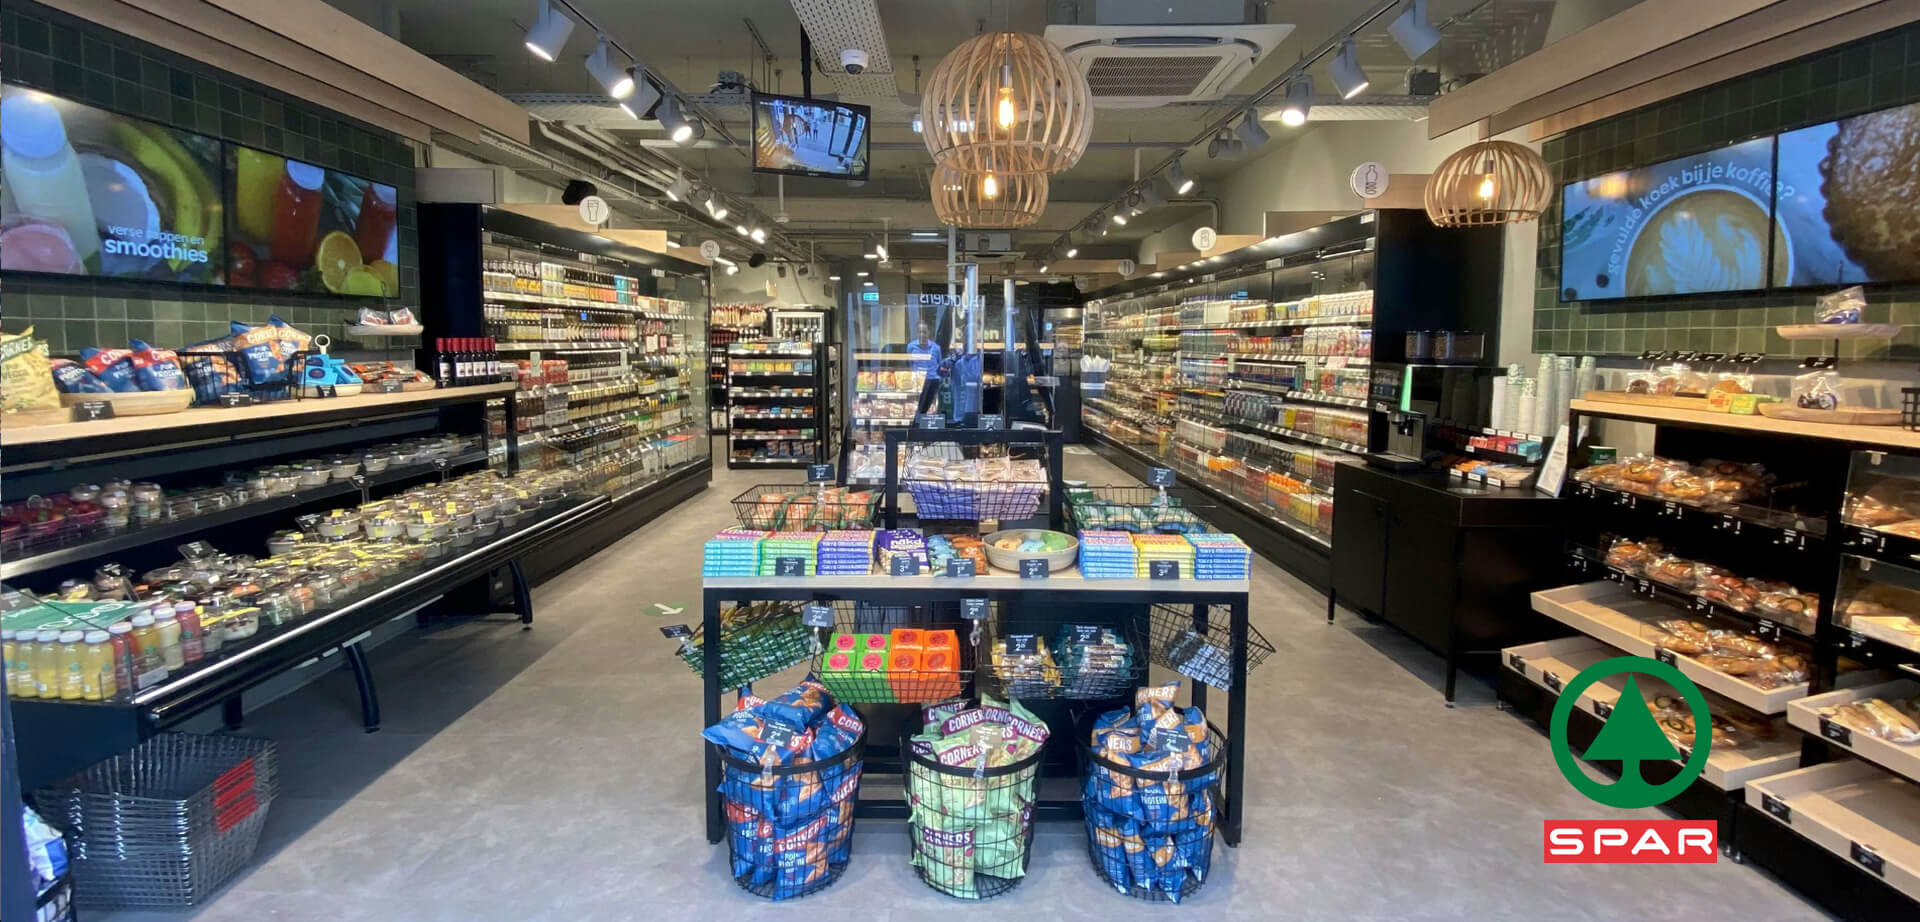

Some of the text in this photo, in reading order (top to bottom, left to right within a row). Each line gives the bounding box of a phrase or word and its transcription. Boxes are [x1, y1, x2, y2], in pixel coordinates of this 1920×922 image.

[1639, 175, 1680, 209] koek
[1681, 164, 1704, 185] bij
[1703, 161, 1723, 183] je
[108, 225, 144, 238] verse
[104, 238, 209, 263] smoothies
